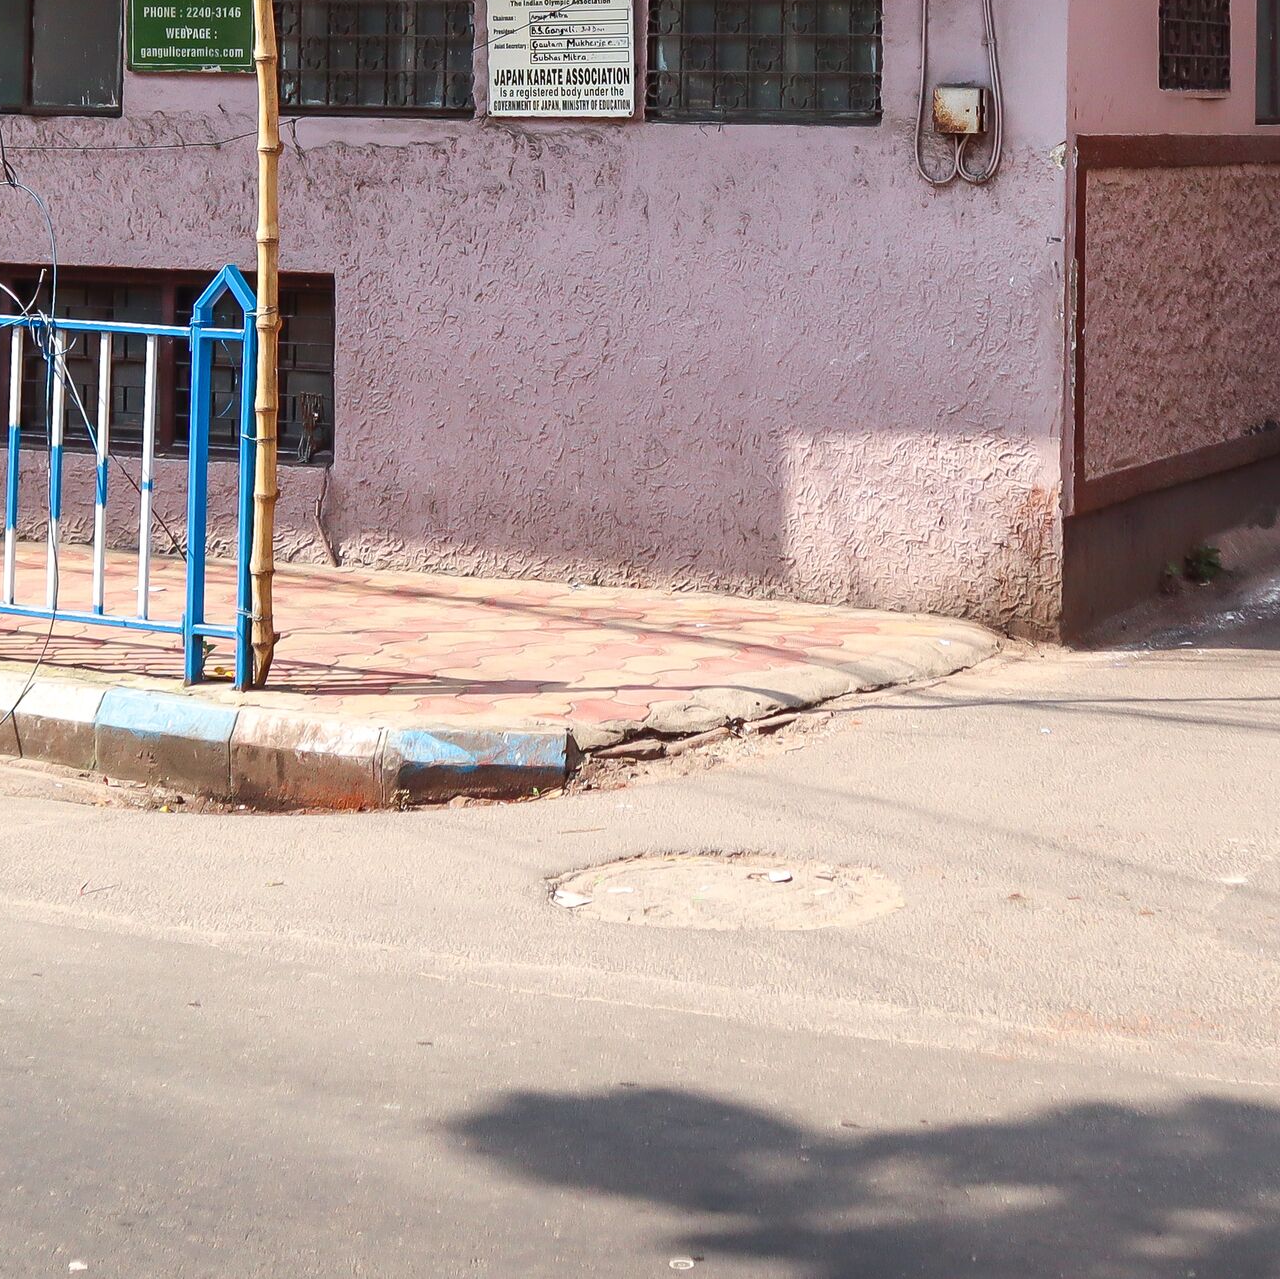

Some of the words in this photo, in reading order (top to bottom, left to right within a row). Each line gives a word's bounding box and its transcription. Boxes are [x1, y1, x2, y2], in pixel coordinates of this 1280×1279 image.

[143, 7, 176, 18] PHONE
[186, 7, 241, 18] 2240-3146
[165, 27, 211, 39] WEBPAGE
[141, 46, 244, 59] ganguliceramics.com
[494, 69, 525, 86] JAPAN
[527, 68, 563, 86] KARATE
[566, 67, 630, 85] ASSOCIATION
[509, 89, 515, 97] a
[516, 87, 559, 99] registered
[560, 86, 581, 99] body
[584, 86, 609, 97] under
[611, 86, 625, 97] the
[493, 100, 531, 111] GOVERNMENT
[533, 100, 540, 110] OF
[562, 99, 590, 111] MINISTRY
[590, 99, 598, 110] OF
[599, 99, 631, 110] EDUCATION
